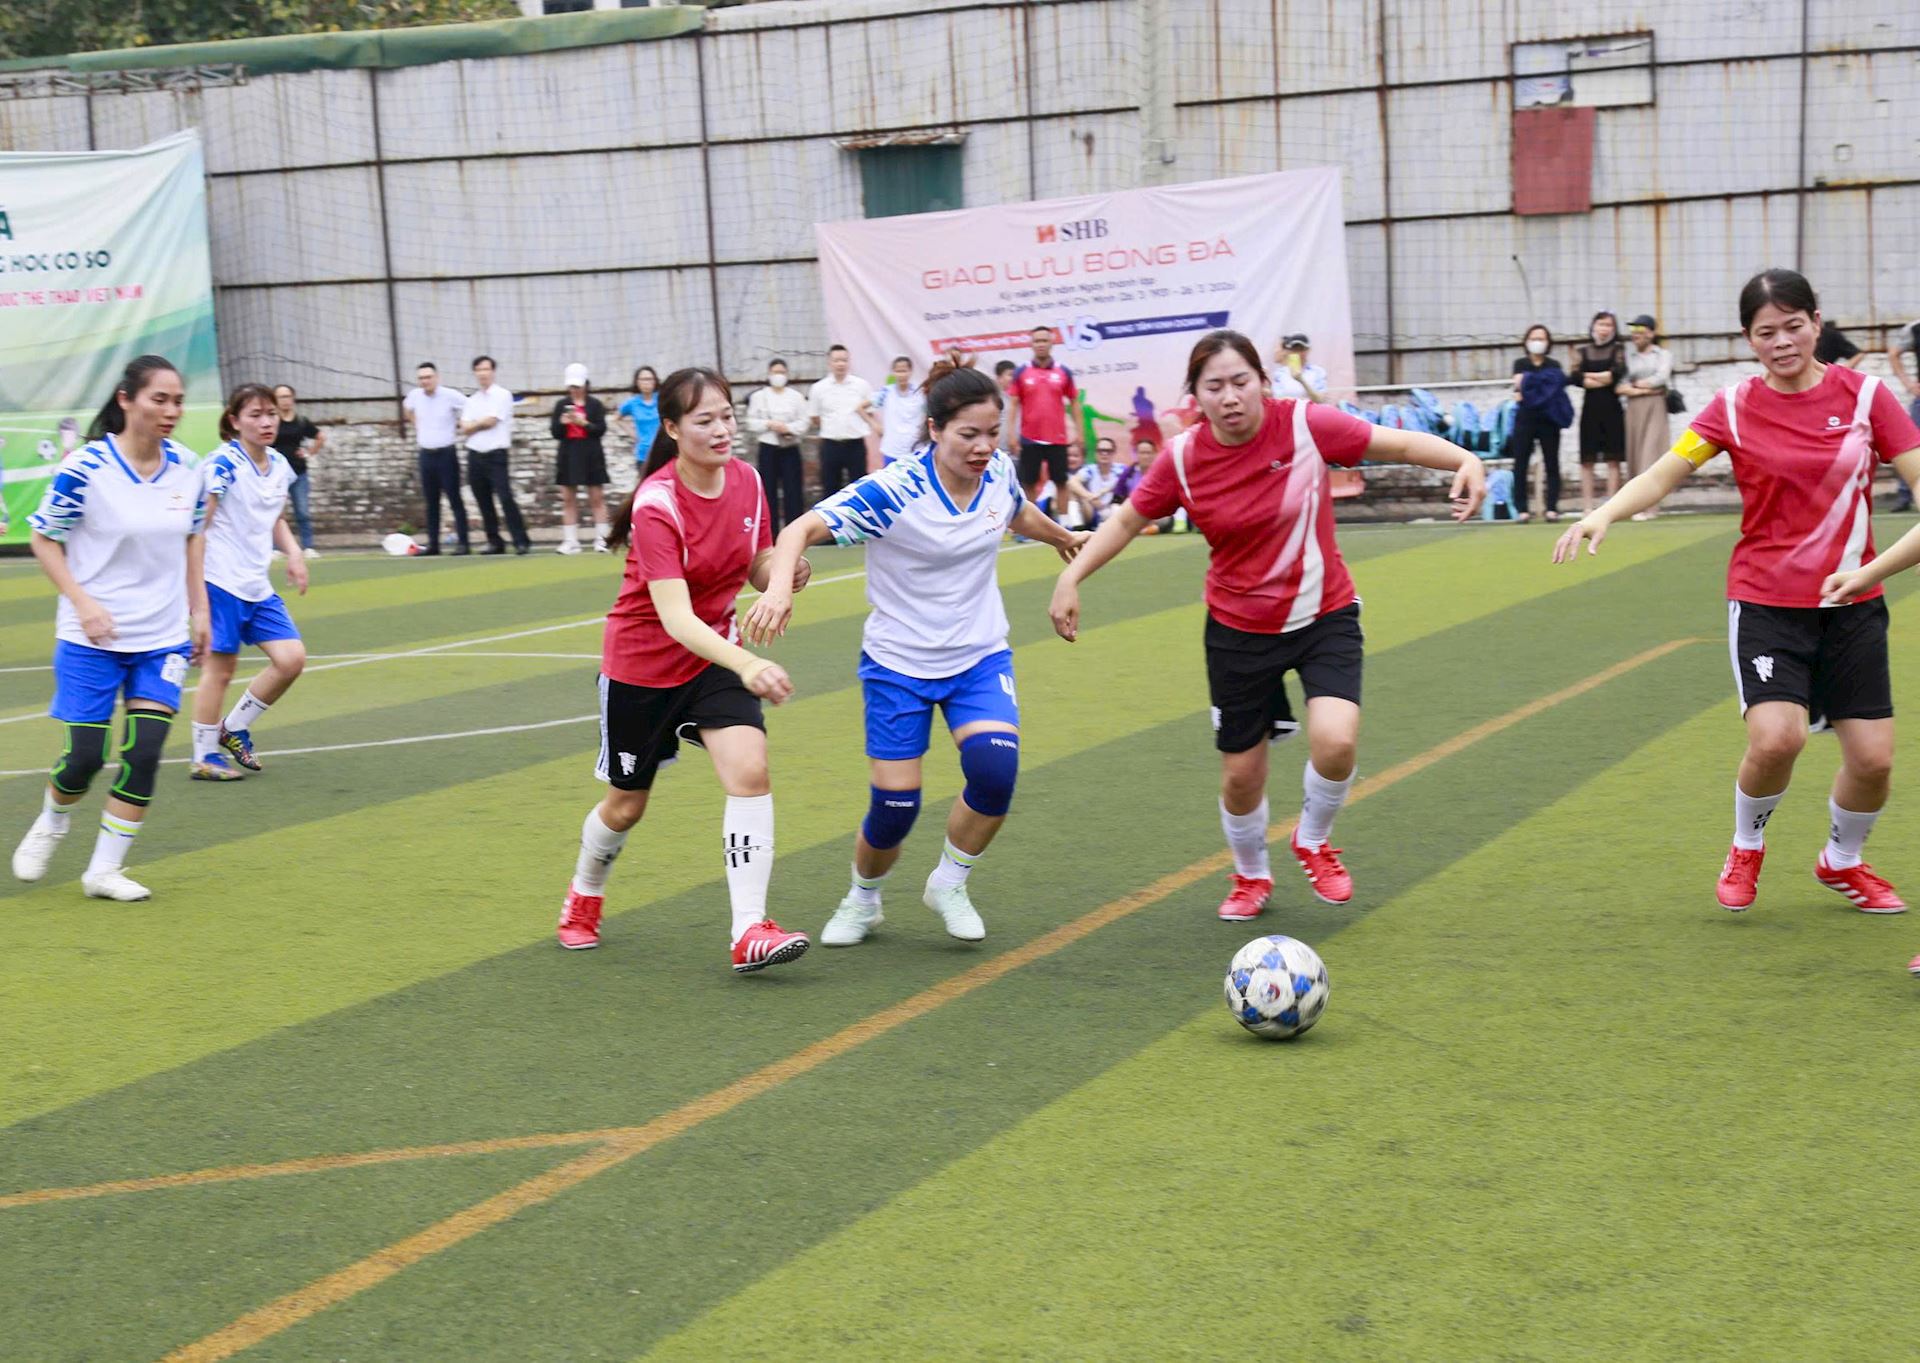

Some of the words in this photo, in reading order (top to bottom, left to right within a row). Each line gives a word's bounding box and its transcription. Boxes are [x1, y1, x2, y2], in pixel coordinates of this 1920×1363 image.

[1061, 218, 1109, 241] SHB
[922, 264, 995, 290] GIAO
[1004, 256, 1073, 281] LƯU
[1056, 315, 1103, 351] VS
